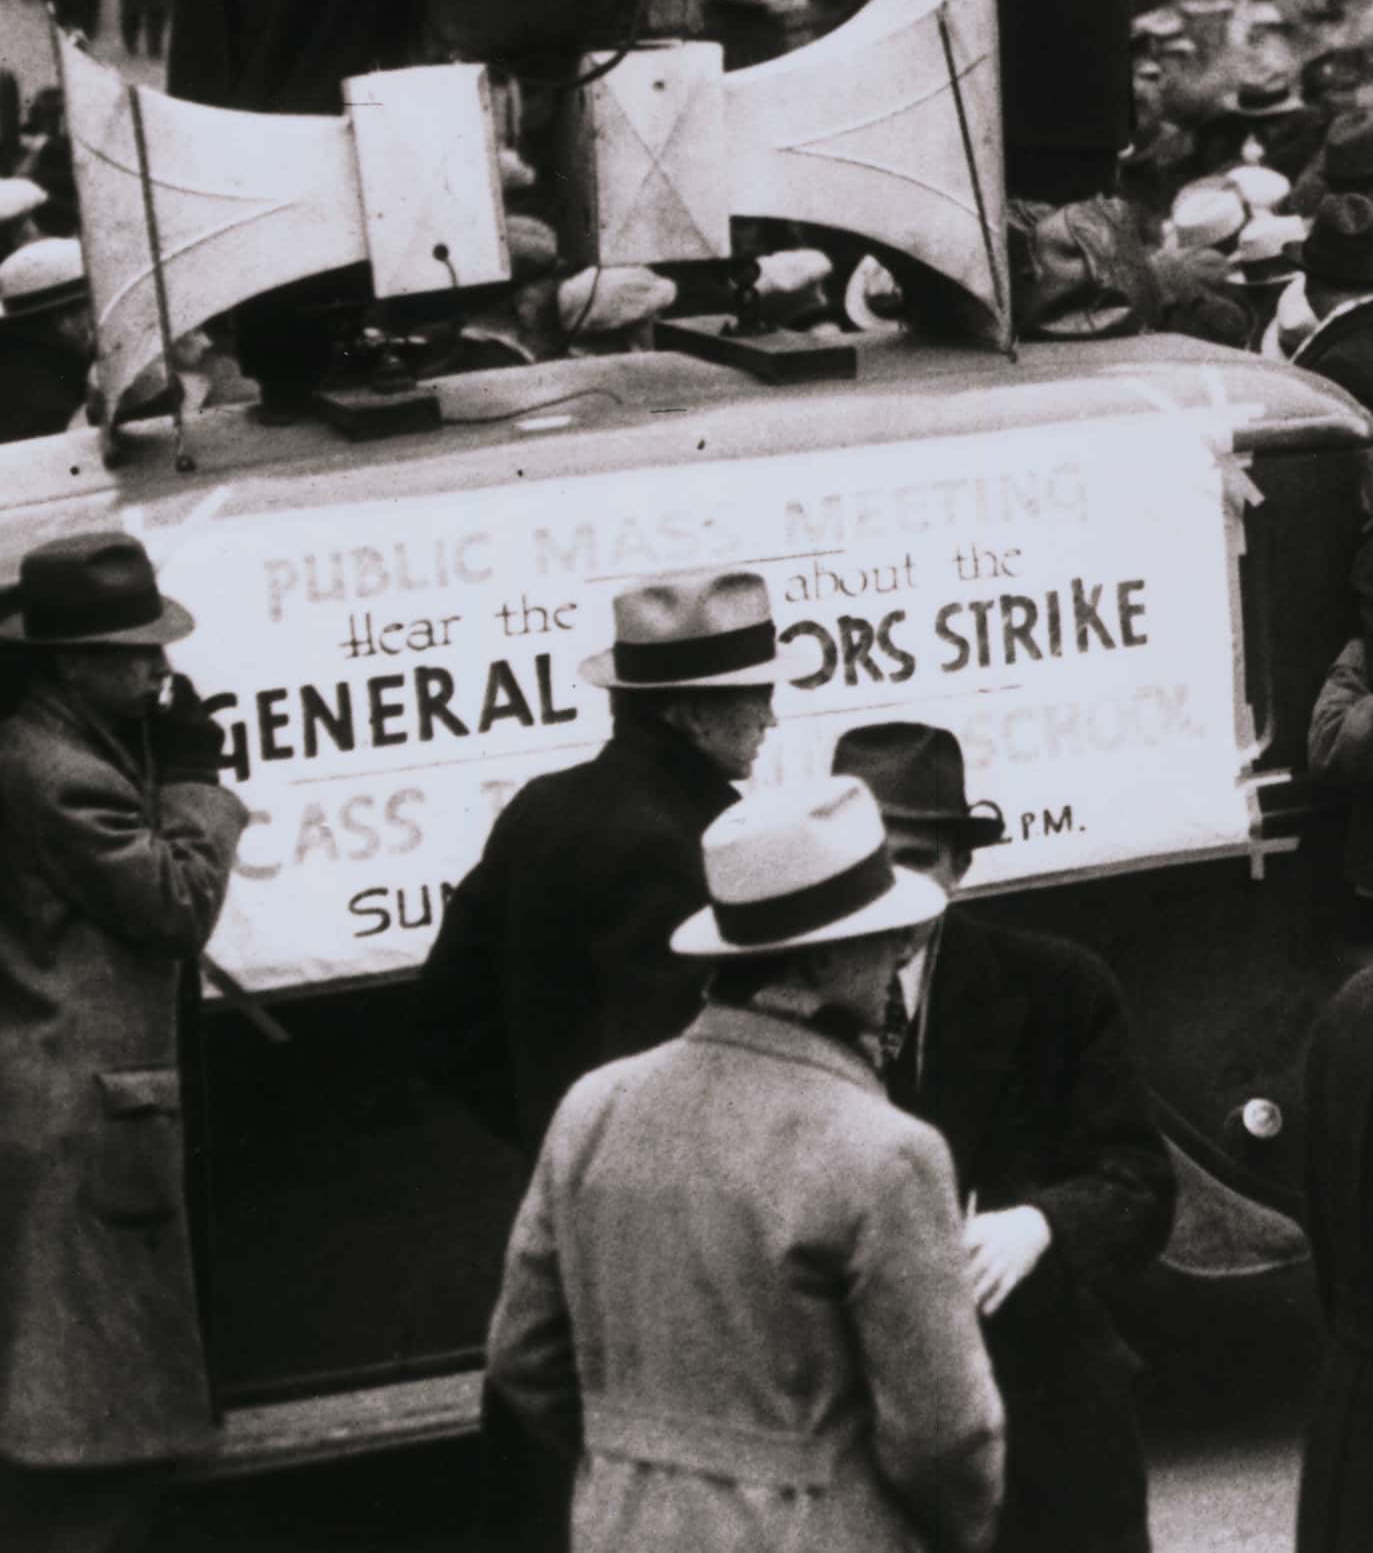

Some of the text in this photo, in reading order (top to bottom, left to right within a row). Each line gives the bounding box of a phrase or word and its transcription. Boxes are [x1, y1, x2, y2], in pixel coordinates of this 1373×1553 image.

[264, 532, 494, 622] PUBLIC
[786, 460, 1090, 542] MEETING
[784, 542, 1024, 604] about the
[340, 593, 578, 660] Hear the
[200, 576, 1148, 783] GENERAL ORS STRIKE
[231, 788, 425, 879] CASS
